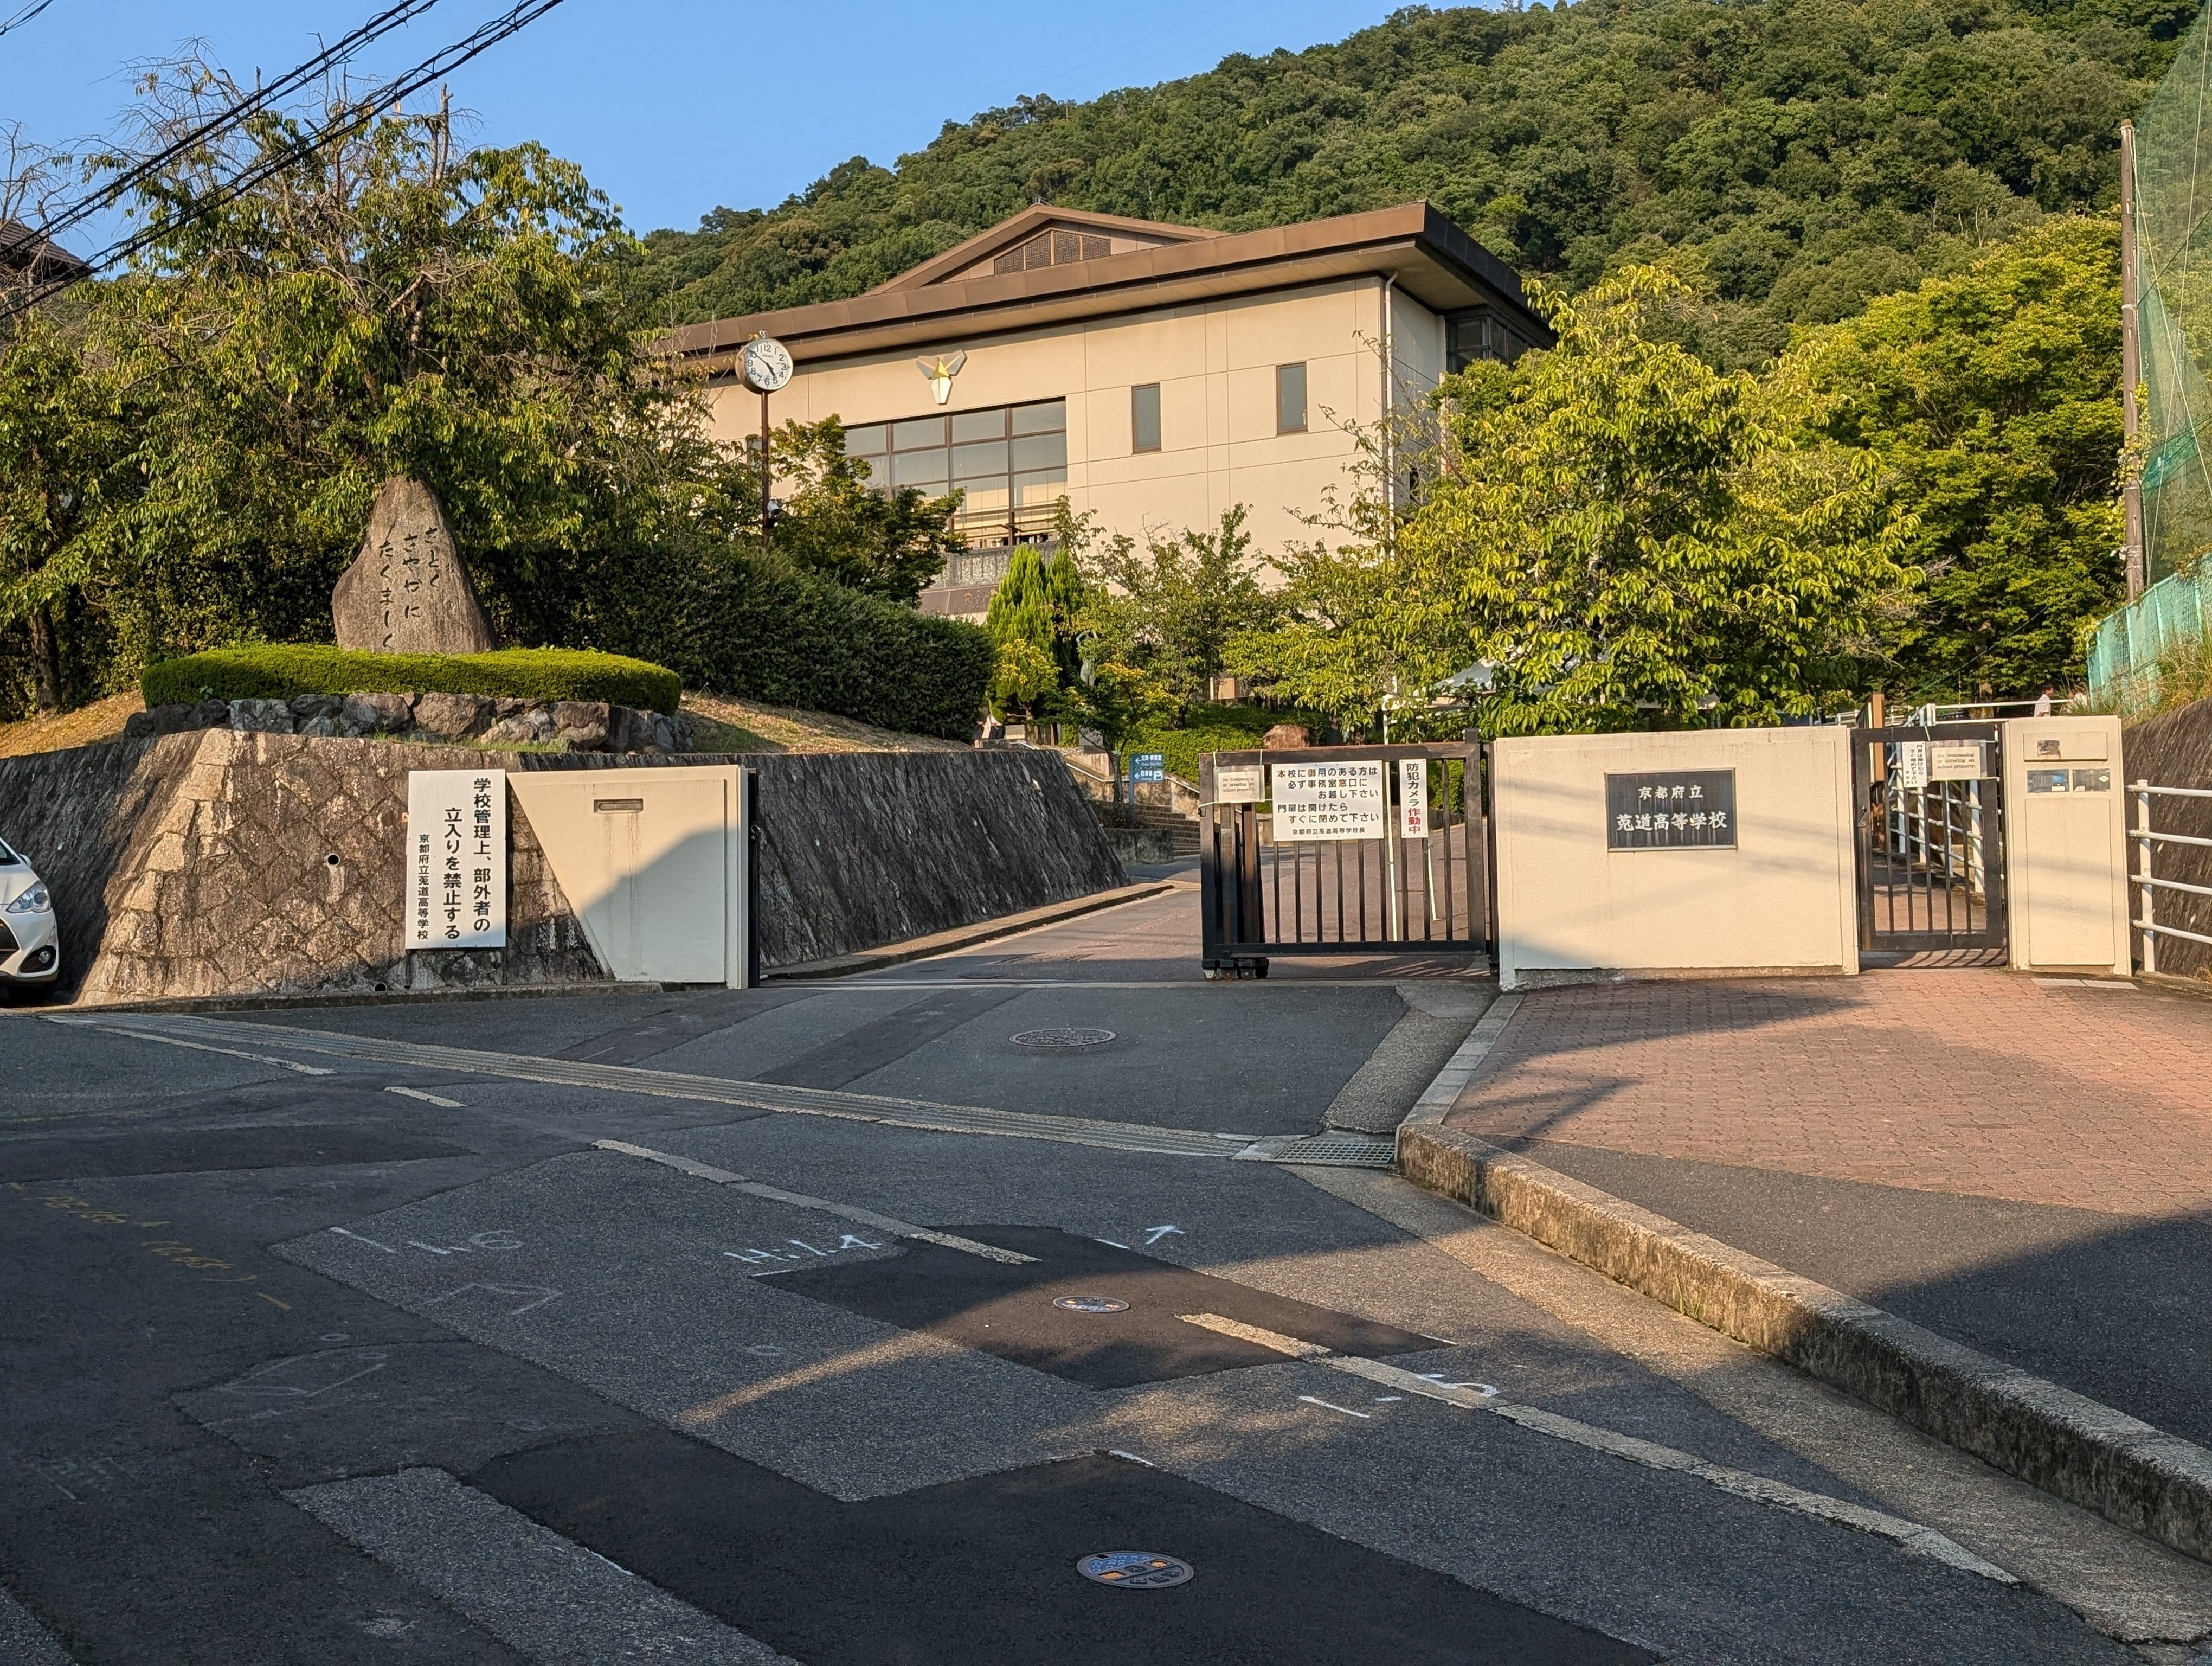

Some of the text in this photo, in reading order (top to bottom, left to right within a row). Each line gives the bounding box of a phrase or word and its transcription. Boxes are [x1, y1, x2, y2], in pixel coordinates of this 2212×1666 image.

[1277, 767, 1378, 778] 本校に御用のある方は
[1288, 778, 1367, 789] 必ず事務室窓口に
[1318, 790, 1378, 799] お越し下さい
[1638, 785, 1703, 800] 京都府立
[1406, 763, 1421, 834] 防犯カメラ作動中
[1278, 803, 1348, 813] 門扉は開けたら
[1288, 813, 1379, 823] すぐに閉めて下さい
[473, 778, 491, 932] 学校管理上、部外者の
[443, 808, 462, 940] 立入りを禁止する
